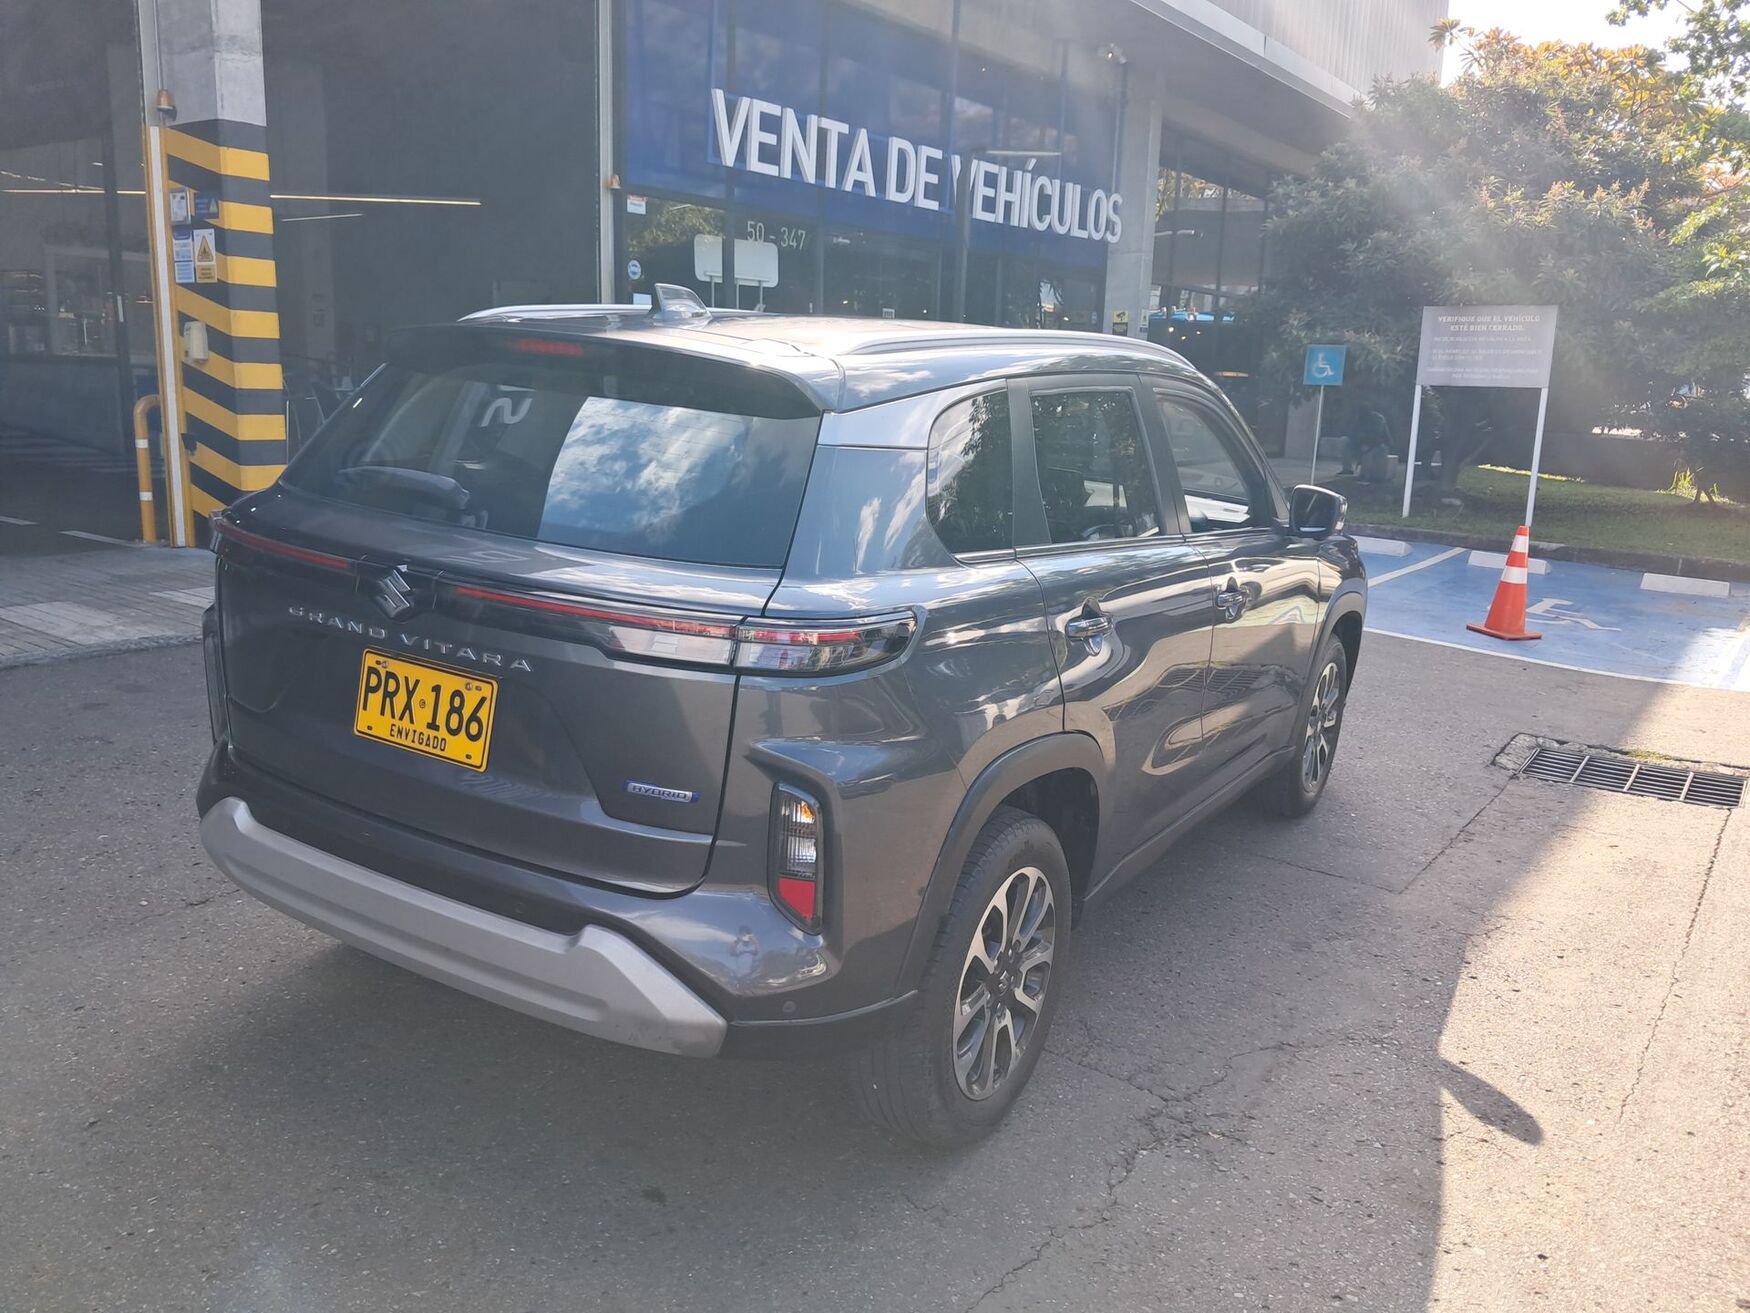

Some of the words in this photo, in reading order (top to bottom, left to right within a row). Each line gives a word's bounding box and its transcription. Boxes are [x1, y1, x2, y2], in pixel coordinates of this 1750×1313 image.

[711, 88, 876, 197] VENTA
[886, 137, 943, 211] DE
[747, 220, 766, 243] 50
[779, 226, 807, 251] 347
[288, 606, 387, 639] GRAND
[399, 632, 533, 672] VITARA
[362, 665, 420, 725] PRX
[426, 684, 488, 743] 186
[389, 723, 448, 752] ENVIGADO
[632, 785, 687, 799] HYBRID
